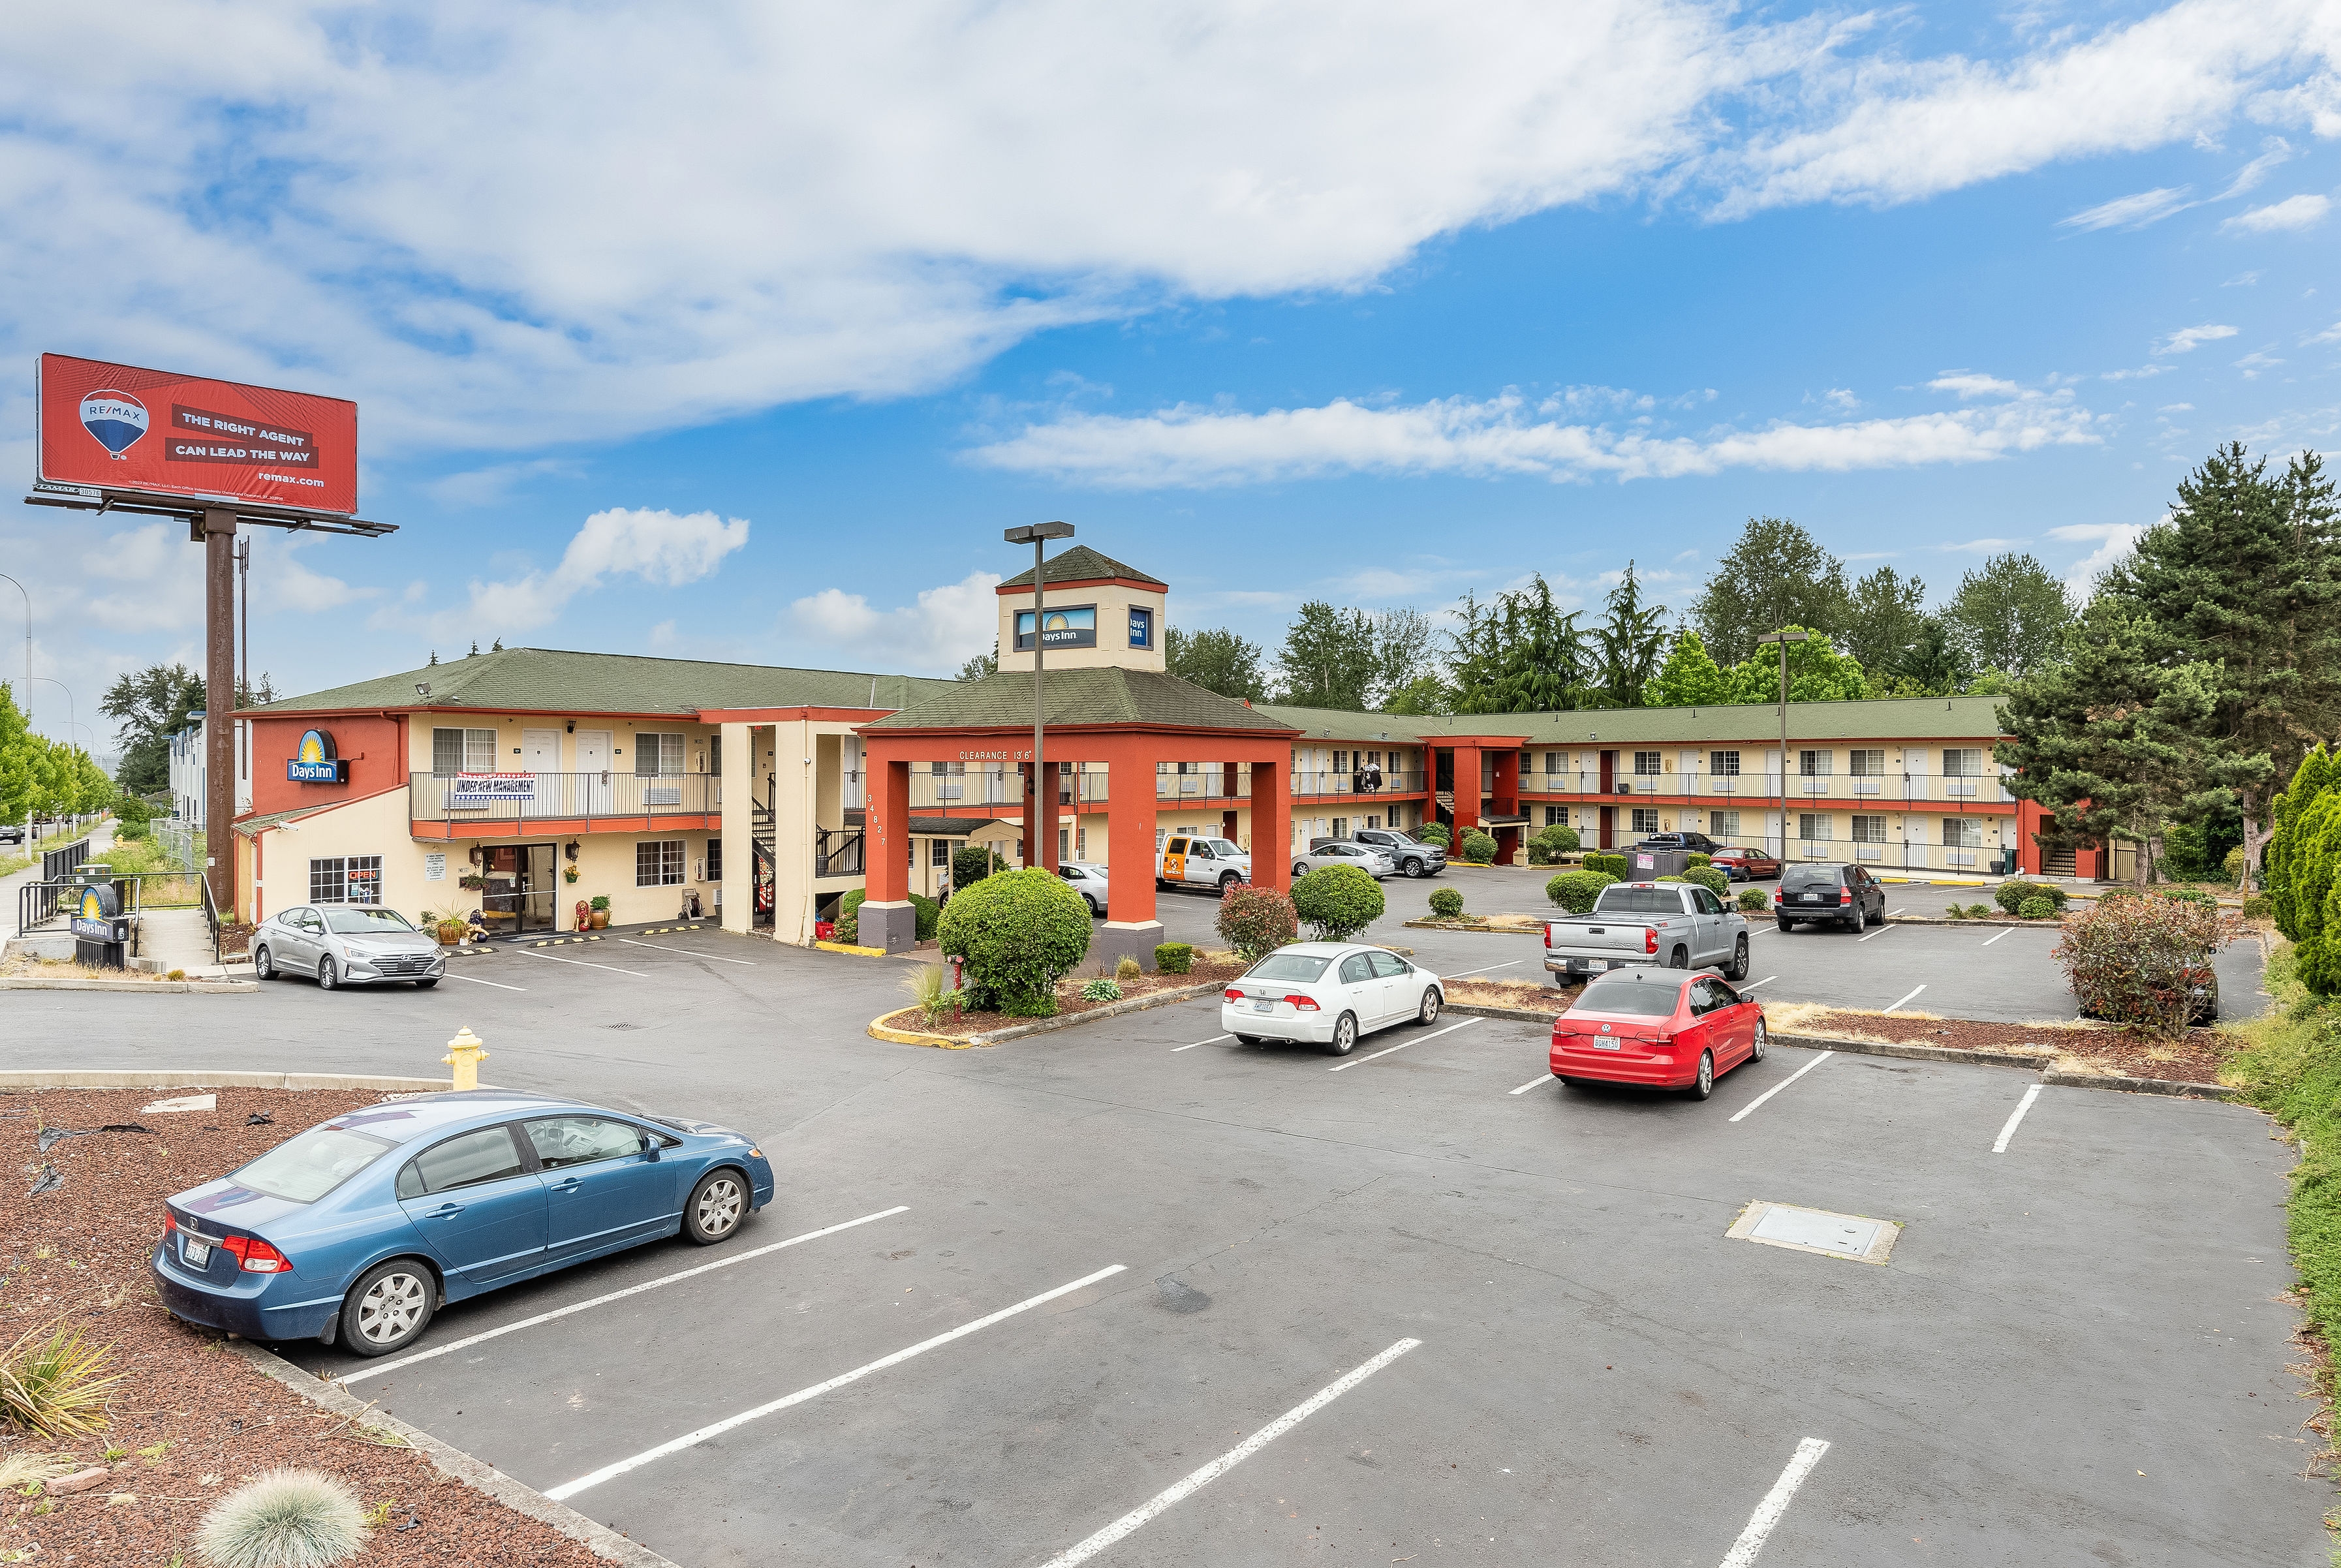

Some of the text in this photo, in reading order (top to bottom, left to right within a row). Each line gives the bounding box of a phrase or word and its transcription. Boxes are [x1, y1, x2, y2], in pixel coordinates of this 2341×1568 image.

[89, 406, 140, 421] RE/MAX
[183, 412, 304, 446] THE RIGHT AGENT
[175, 445, 310, 462] CAN LEAD THE WAY
[258, 472, 324, 487] remax.com
[37, 484, 79, 493] LAMAR
[1061, 631, 1076, 639] Inn
[959, 751, 1008, 760] CLEARANCE
[292, 764, 332, 779] Days Inn
[457, 779, 534, 793] UNDER NEW MANAGEMENT
[76, 919, 94, 934] Days
[95, 921, 108, 936] Inn
